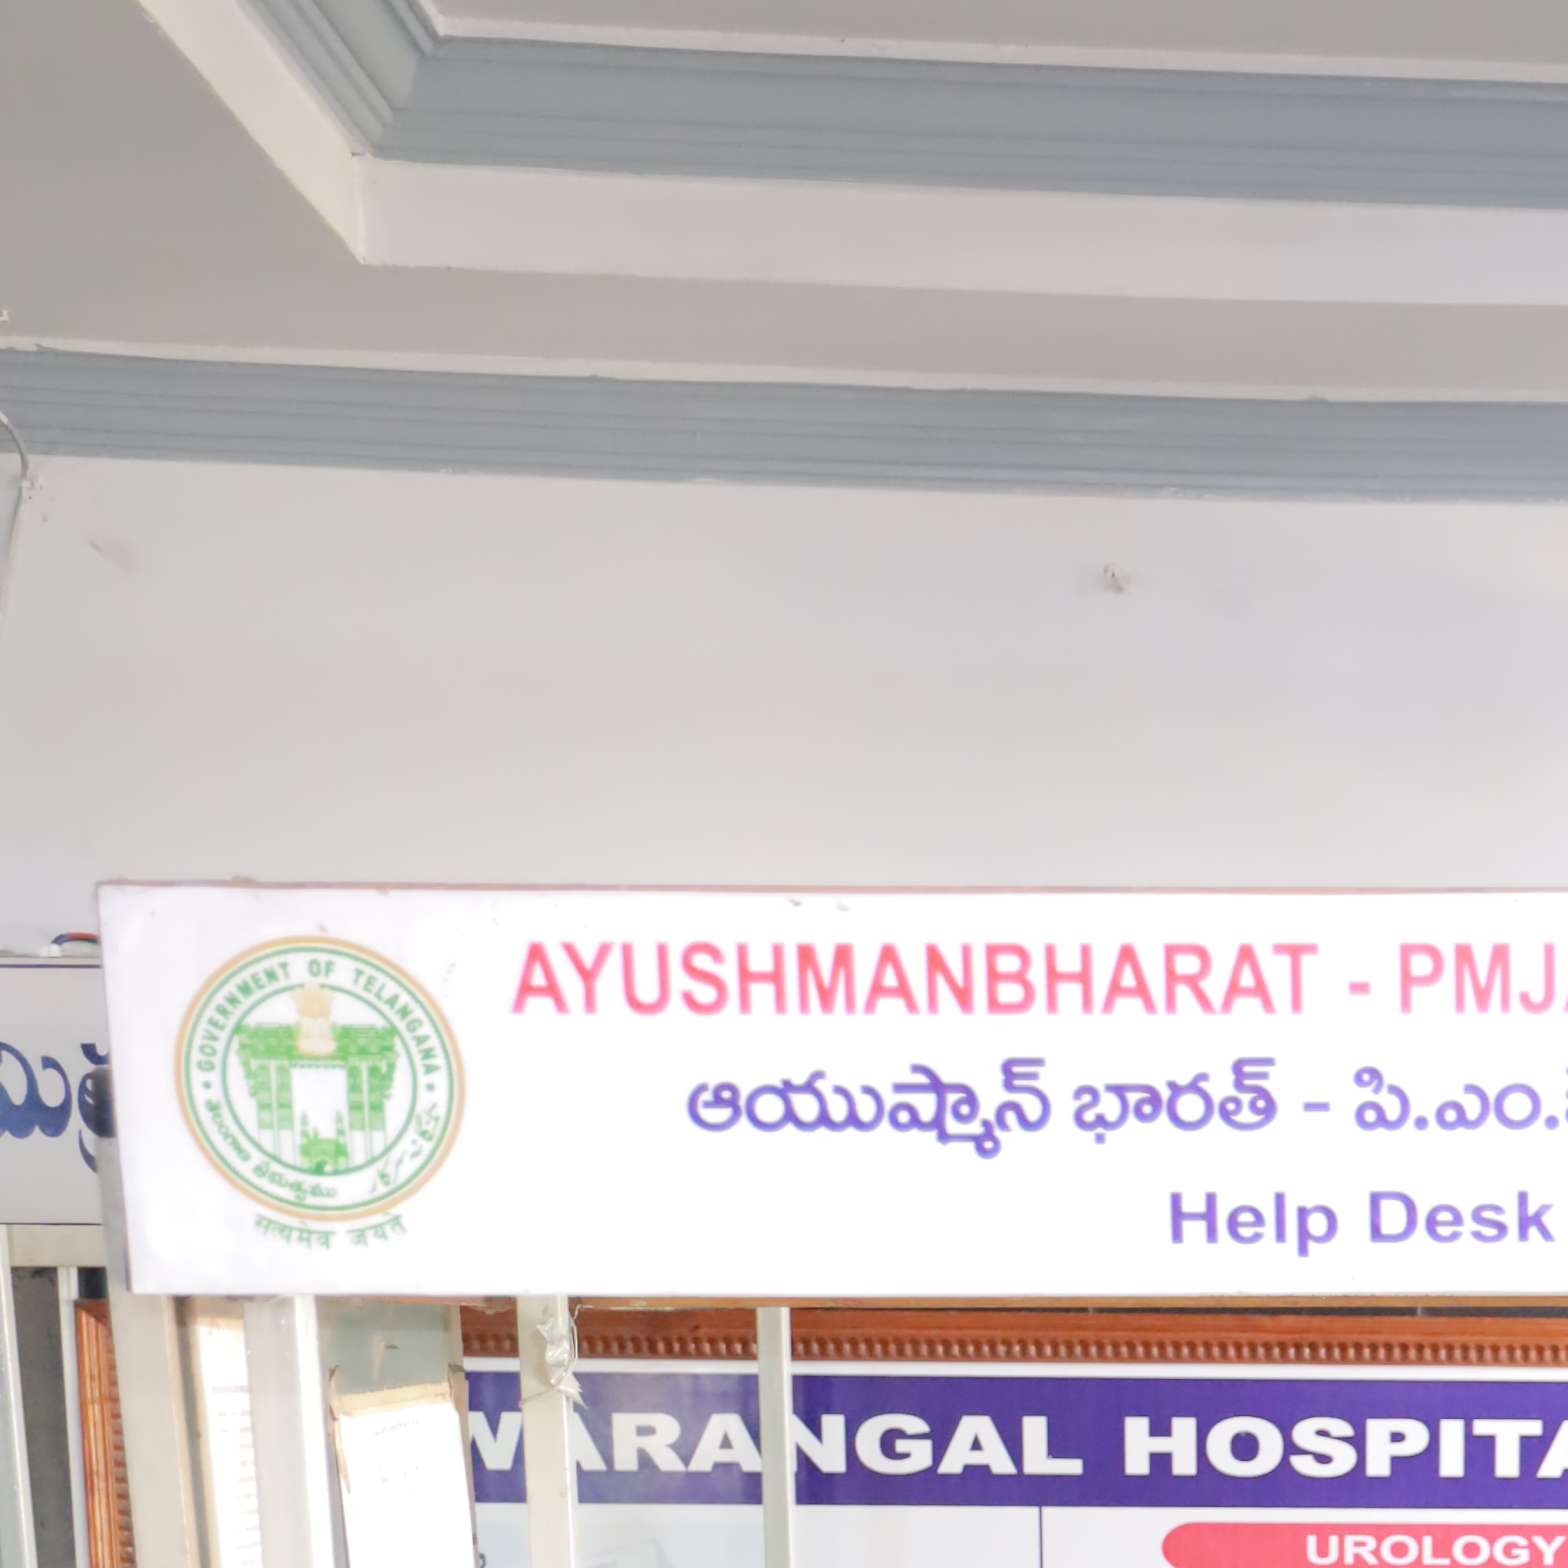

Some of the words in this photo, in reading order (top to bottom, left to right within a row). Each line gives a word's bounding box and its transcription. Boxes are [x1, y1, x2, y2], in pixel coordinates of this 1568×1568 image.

[512, 942, 1317, 1015] AYUSHMANBHARAT
[196, 961, 290, 1073] GOVERNMENT
[308, 958, 335, 977] OF
[352, 967, 441, 1076] TELANGANA
[687, 1058, 1050, 1159] ఆయుష్మాన్
[1073, 1058, 1277, 1144] భారత్
[1171, 1192, 1337, 1257] Help
[1370, 1191, 1553, 1242] Desk
[464, 1411, 1082, 1475] WRANGAL
[1307, 1535, 1566, 1566] UROLOGY
